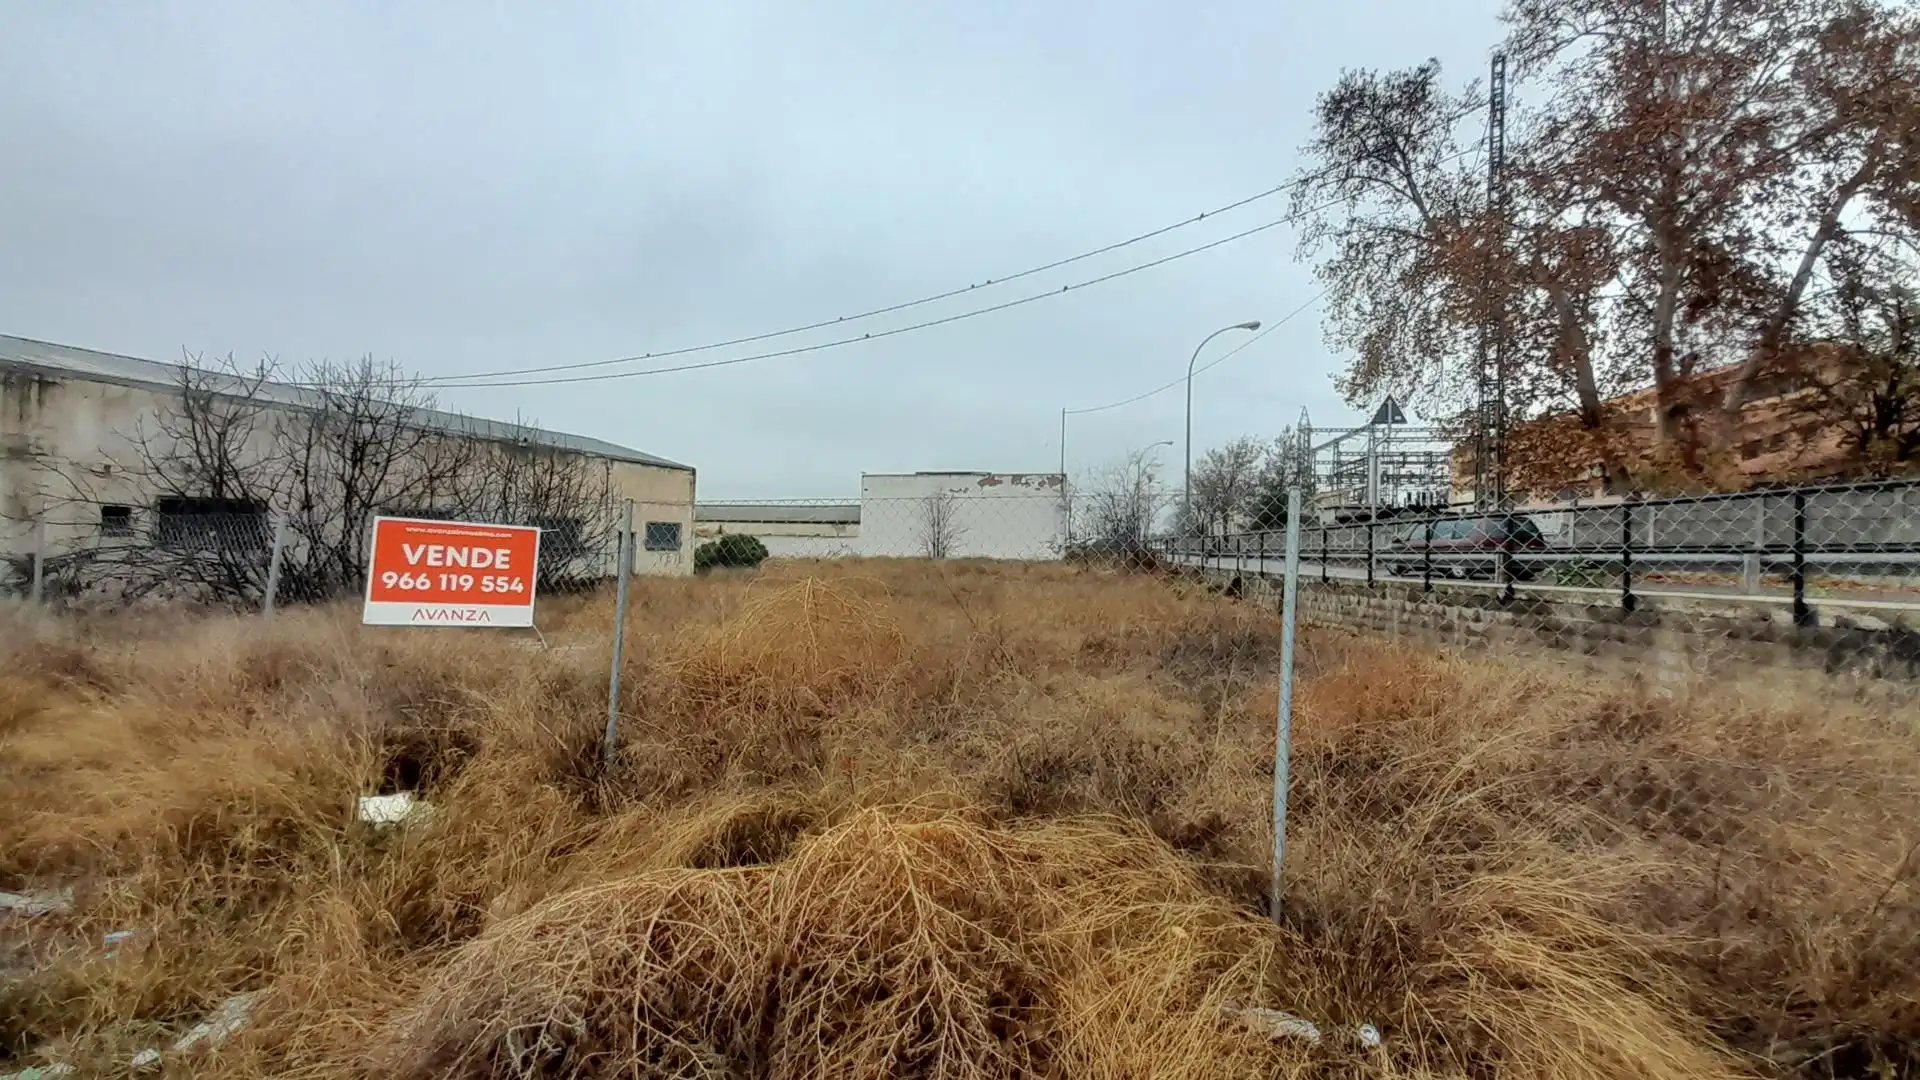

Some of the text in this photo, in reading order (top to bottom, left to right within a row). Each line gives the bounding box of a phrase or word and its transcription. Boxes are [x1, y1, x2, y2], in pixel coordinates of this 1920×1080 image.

[402, 544, 511, 569] VENDE
[382, 571, 524, 593] 966 119 554
[411, 608, 491, 622] AVANZA
